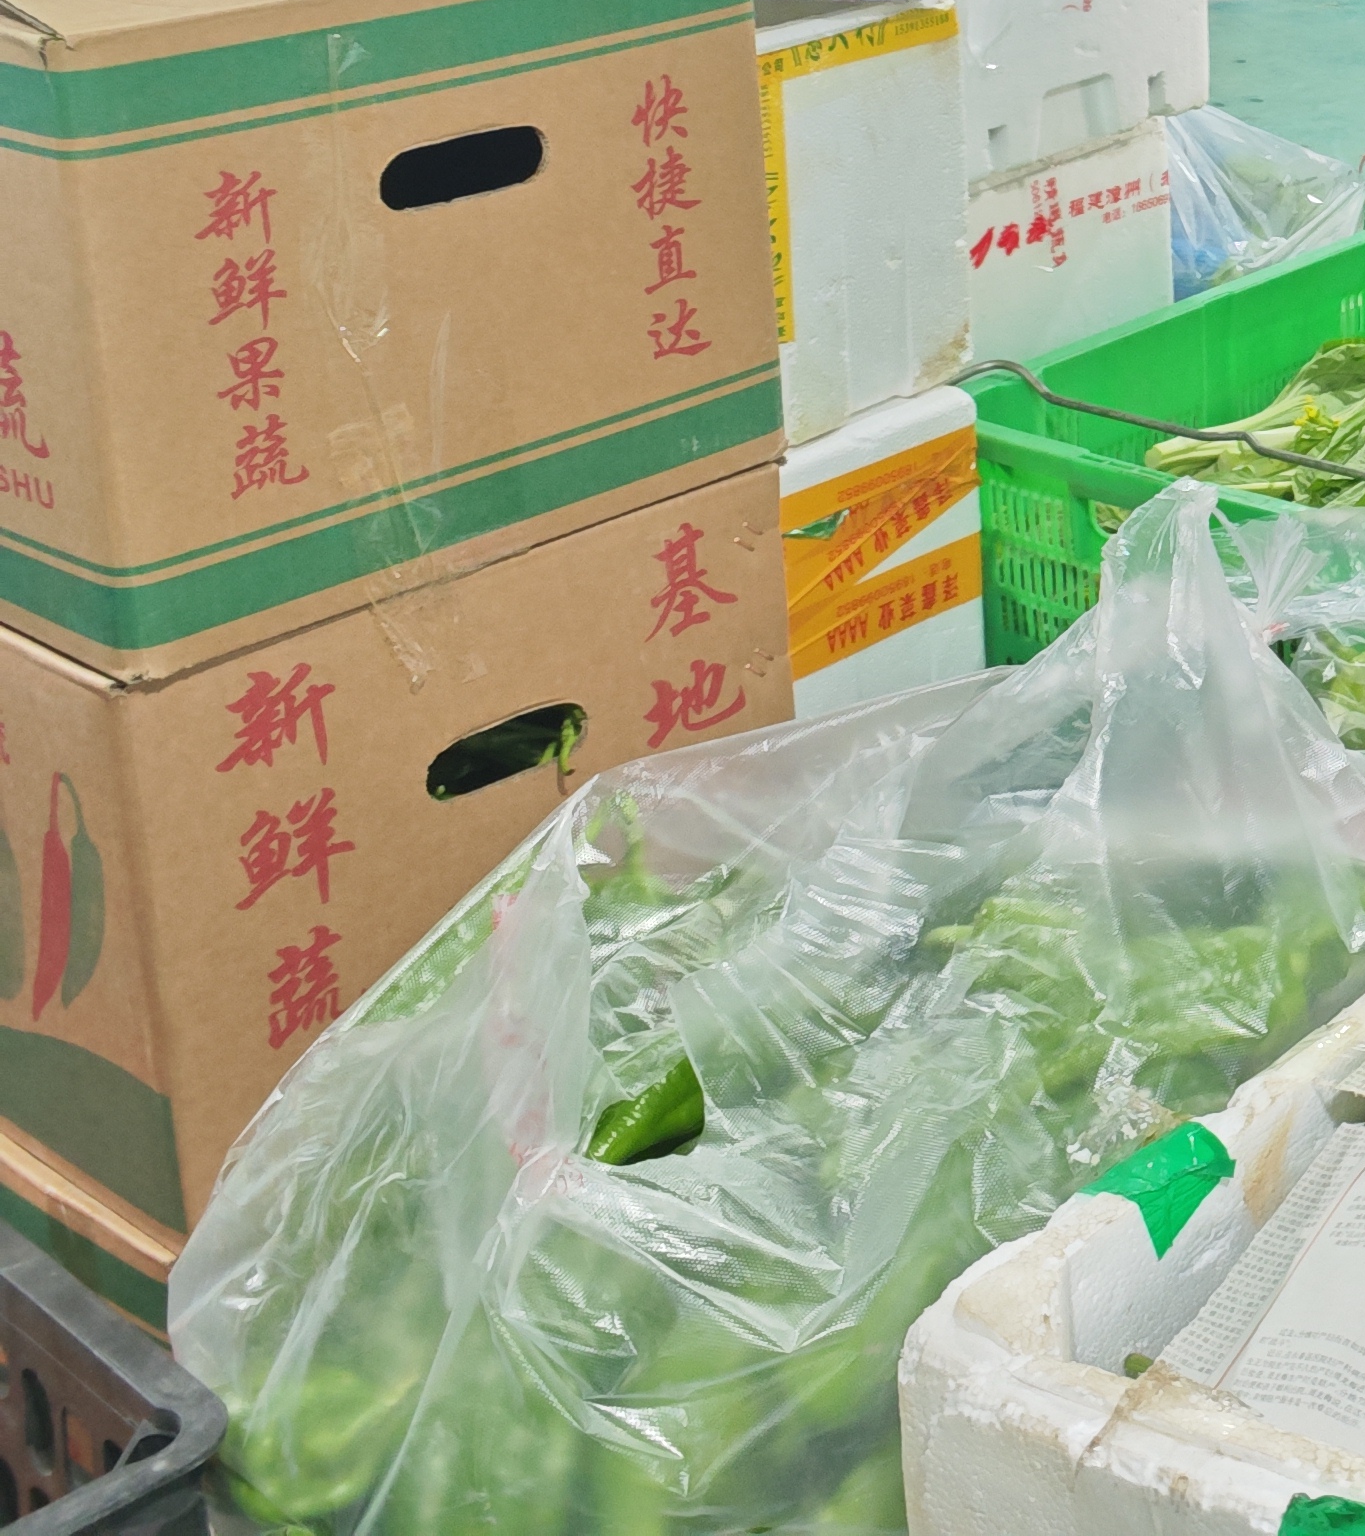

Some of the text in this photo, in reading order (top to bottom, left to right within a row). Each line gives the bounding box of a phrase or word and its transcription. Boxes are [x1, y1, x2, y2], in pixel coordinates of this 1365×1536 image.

[194, 170, 309, 500] 新鲜果蔬
[631, 75, 711, 359] 快捷直达
[644, 523, 747, 748] 基地
